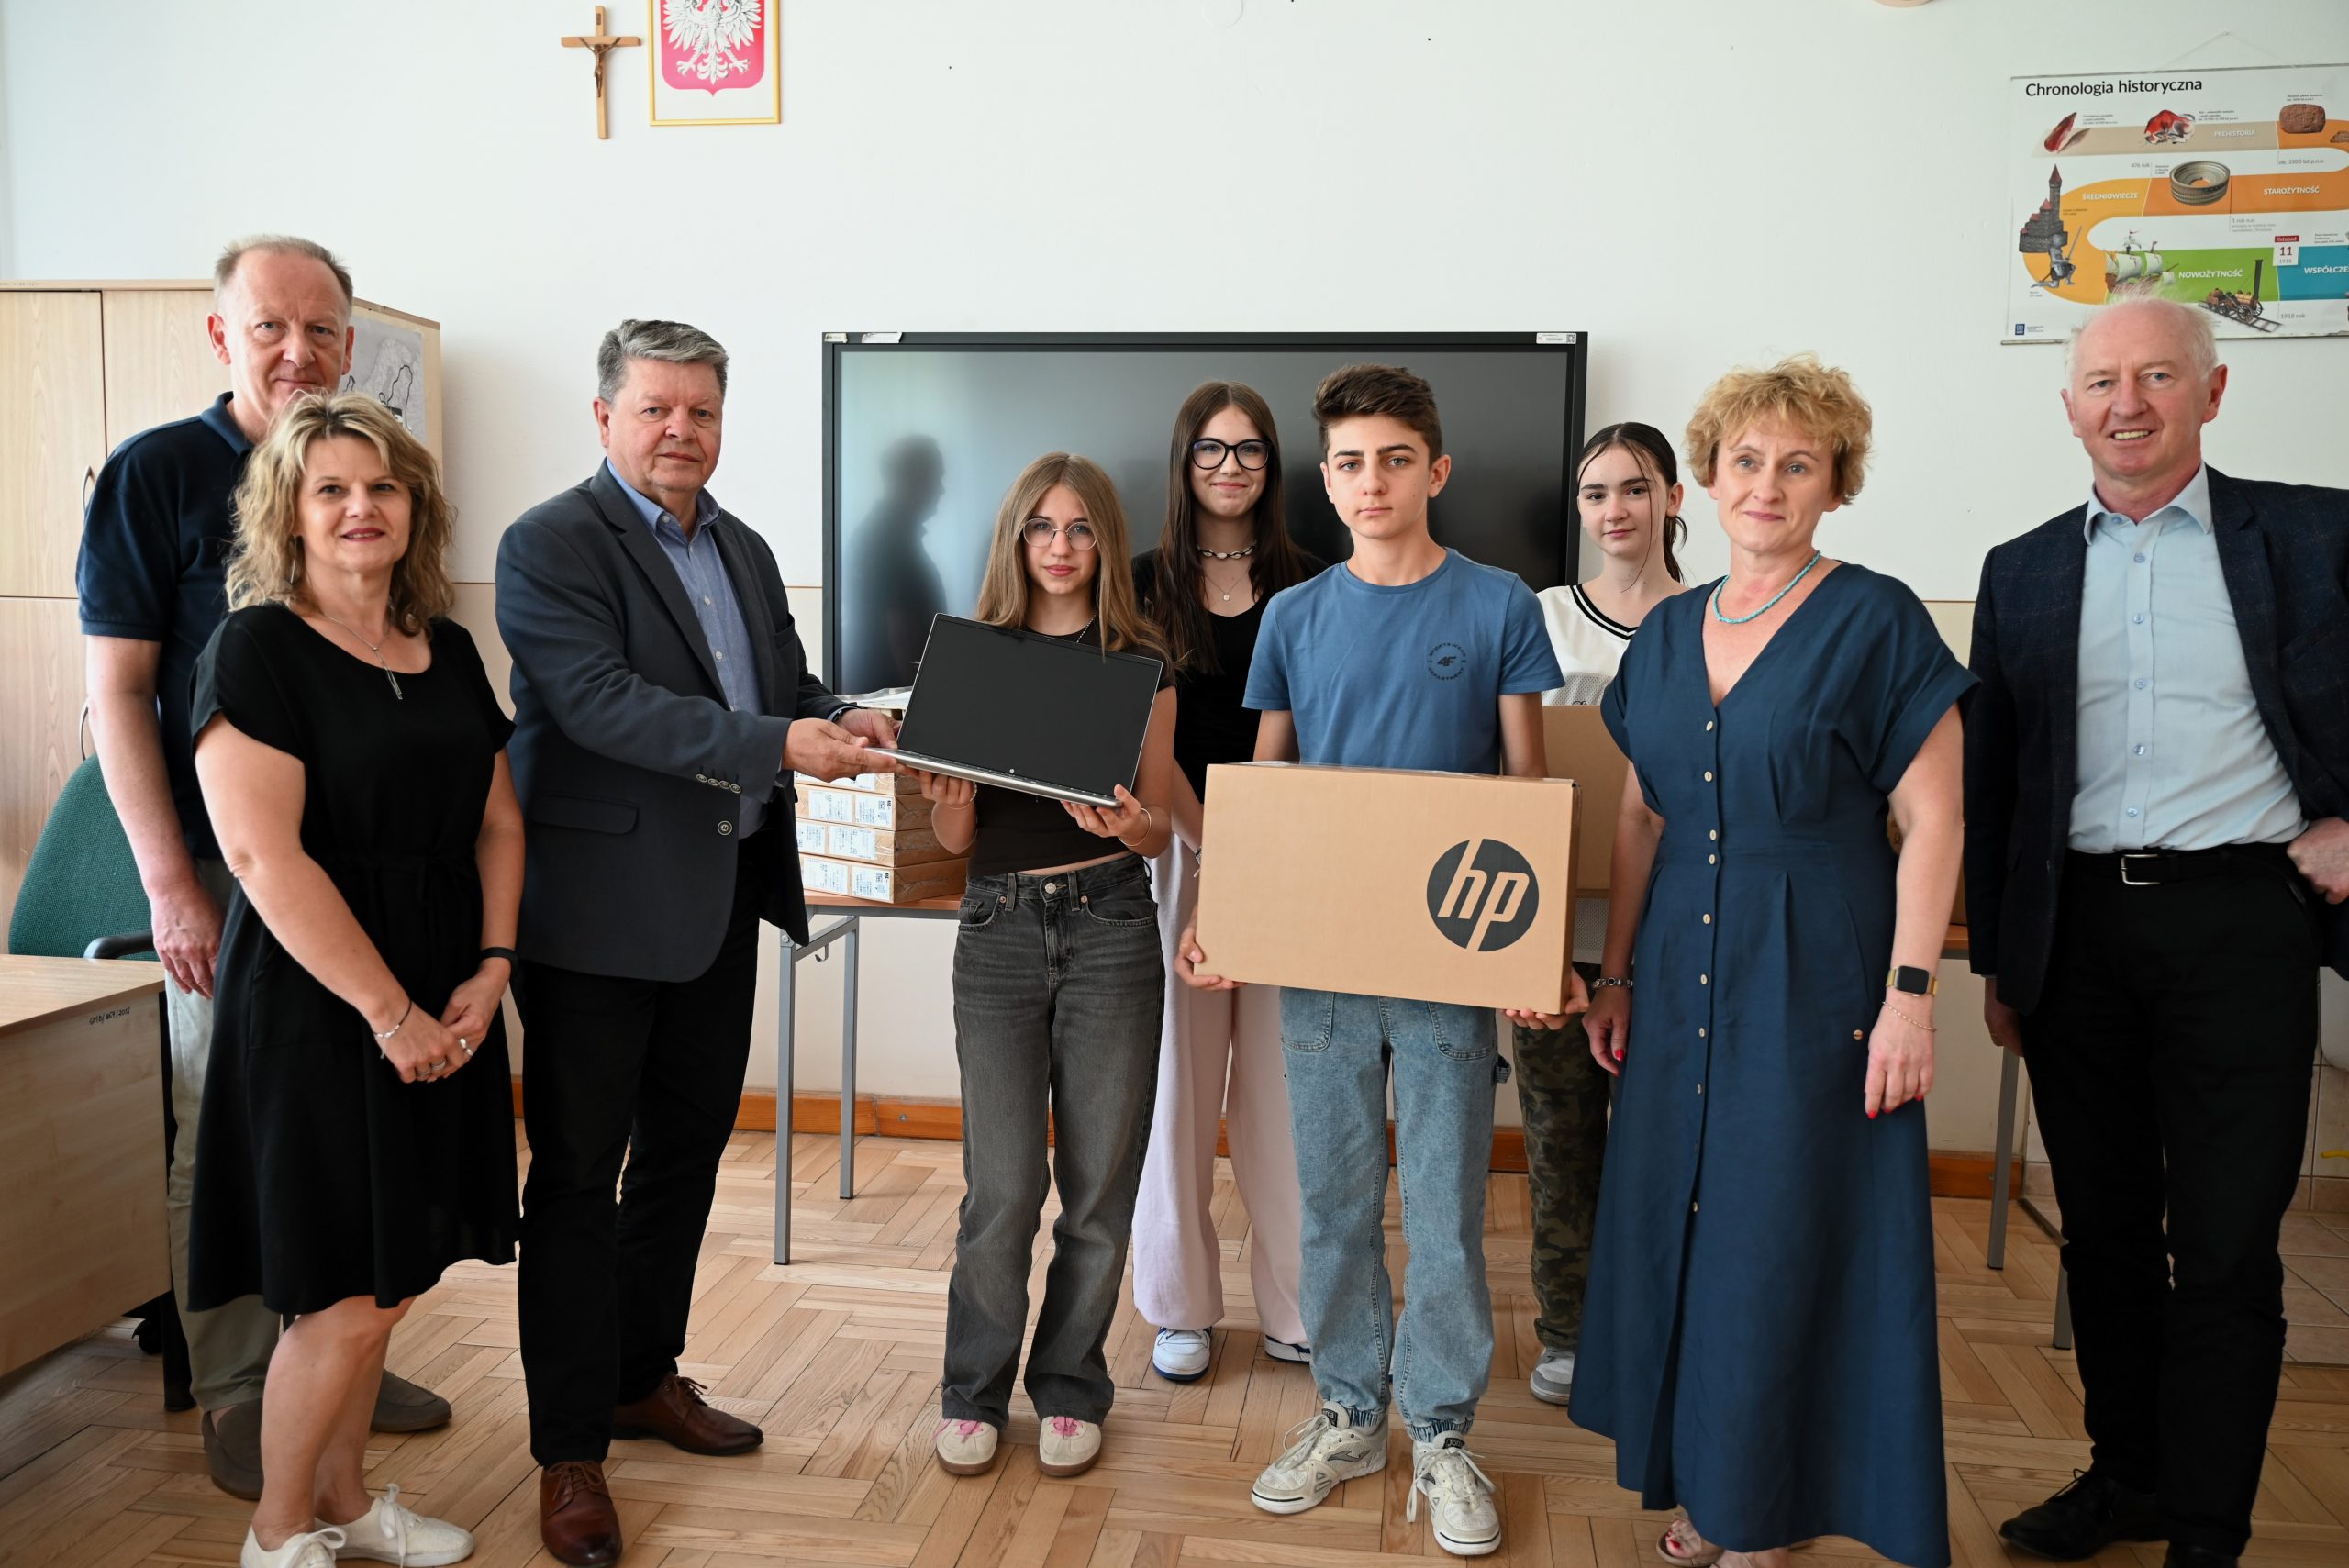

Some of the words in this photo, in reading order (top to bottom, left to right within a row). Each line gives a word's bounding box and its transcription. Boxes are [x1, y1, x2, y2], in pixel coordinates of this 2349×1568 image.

[2025, 81, 2114, 97] Chronologia
[2118, 79, 2203, 95] historyczna
[2263, 186, 2320, 195] STAROŻYTNOŚĆ
[2279, 246, 2293, 256] 11
[2178, 269, 2243, 278] NOWOŻYTNOŚĆ
[2304, 265, 2349, 274] WSPÓŁCZE
[1436, 838, 1531, 952] hp
